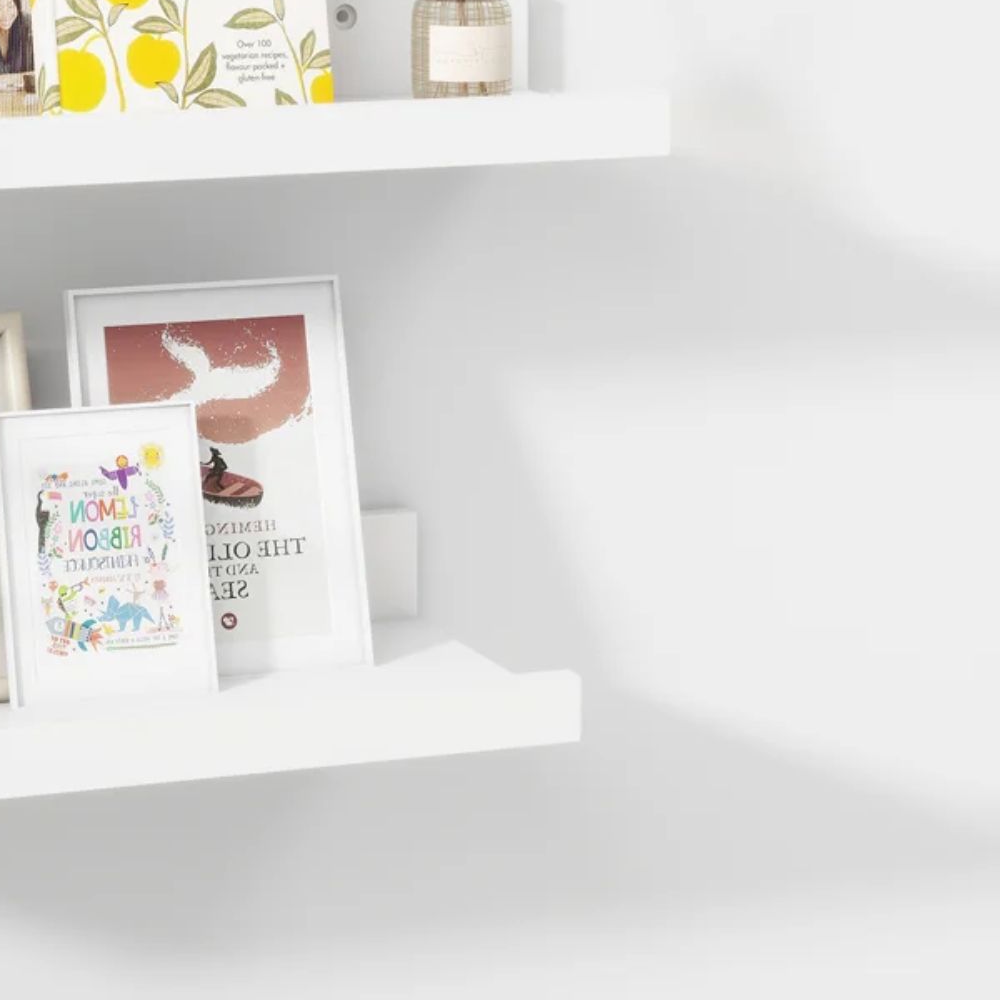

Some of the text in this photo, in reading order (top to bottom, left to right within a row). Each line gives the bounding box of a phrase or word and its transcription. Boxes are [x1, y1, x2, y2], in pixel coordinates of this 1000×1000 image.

[236, 39, 272, 48] Over 100
[222, 52, 259, 62] vegetarian
